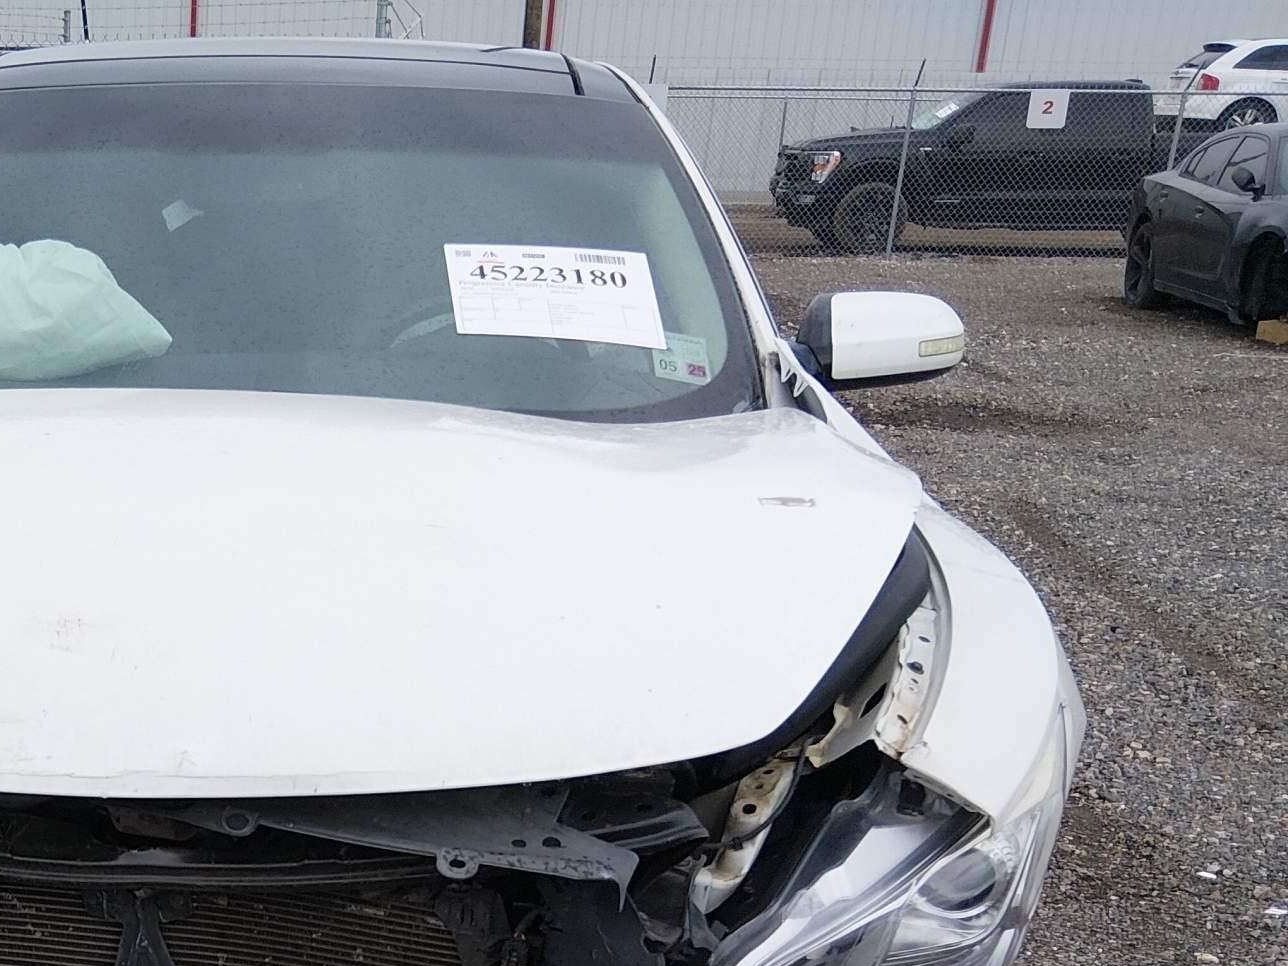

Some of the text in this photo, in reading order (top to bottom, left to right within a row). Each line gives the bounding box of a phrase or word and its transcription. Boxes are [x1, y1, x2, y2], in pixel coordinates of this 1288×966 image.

[1042, 100, 1054, 115] 2
[469, 264, 628, 289] 45223180
[659, 359, 678, 373] 05
